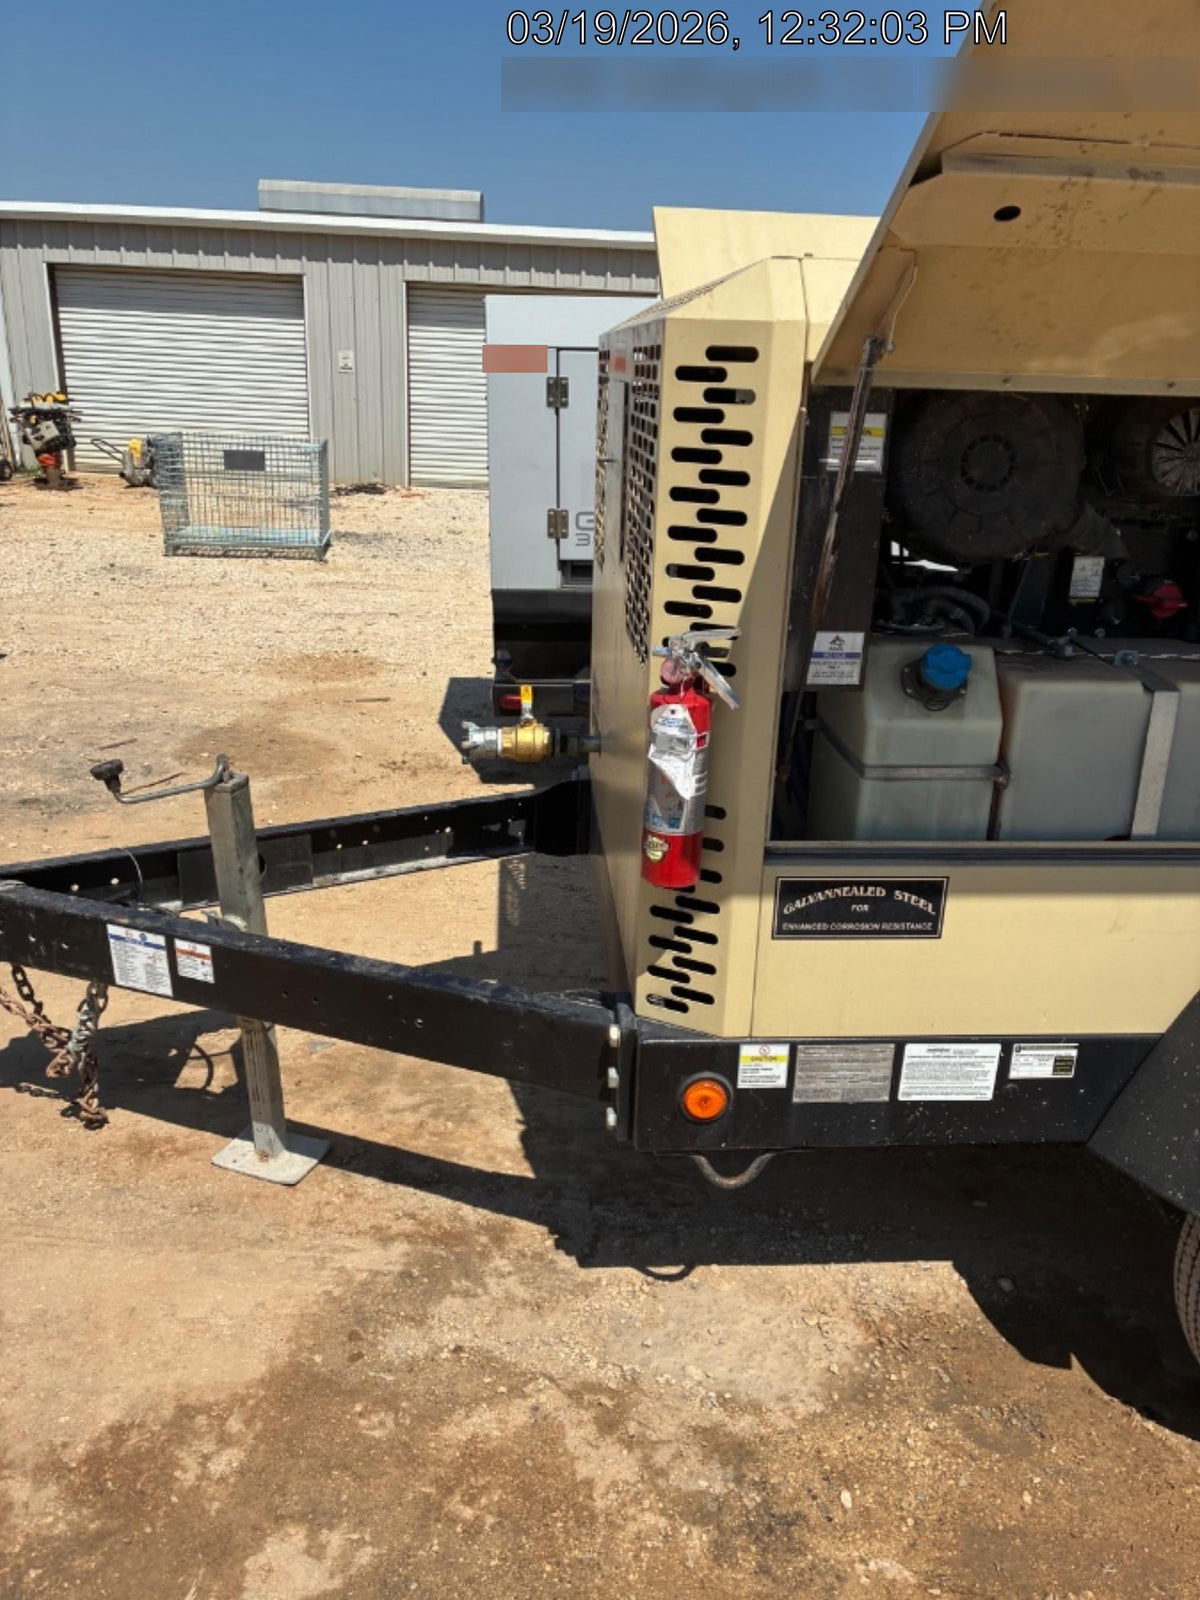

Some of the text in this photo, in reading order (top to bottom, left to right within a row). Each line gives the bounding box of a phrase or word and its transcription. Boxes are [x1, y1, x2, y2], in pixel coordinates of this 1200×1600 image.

[783, 886, 936, 915] GALVANNEALED STEEL
[851, 904, 869, 912] FOR
[782, 922, 933, 931] ENHANCED CORROSION RESISTANCE
